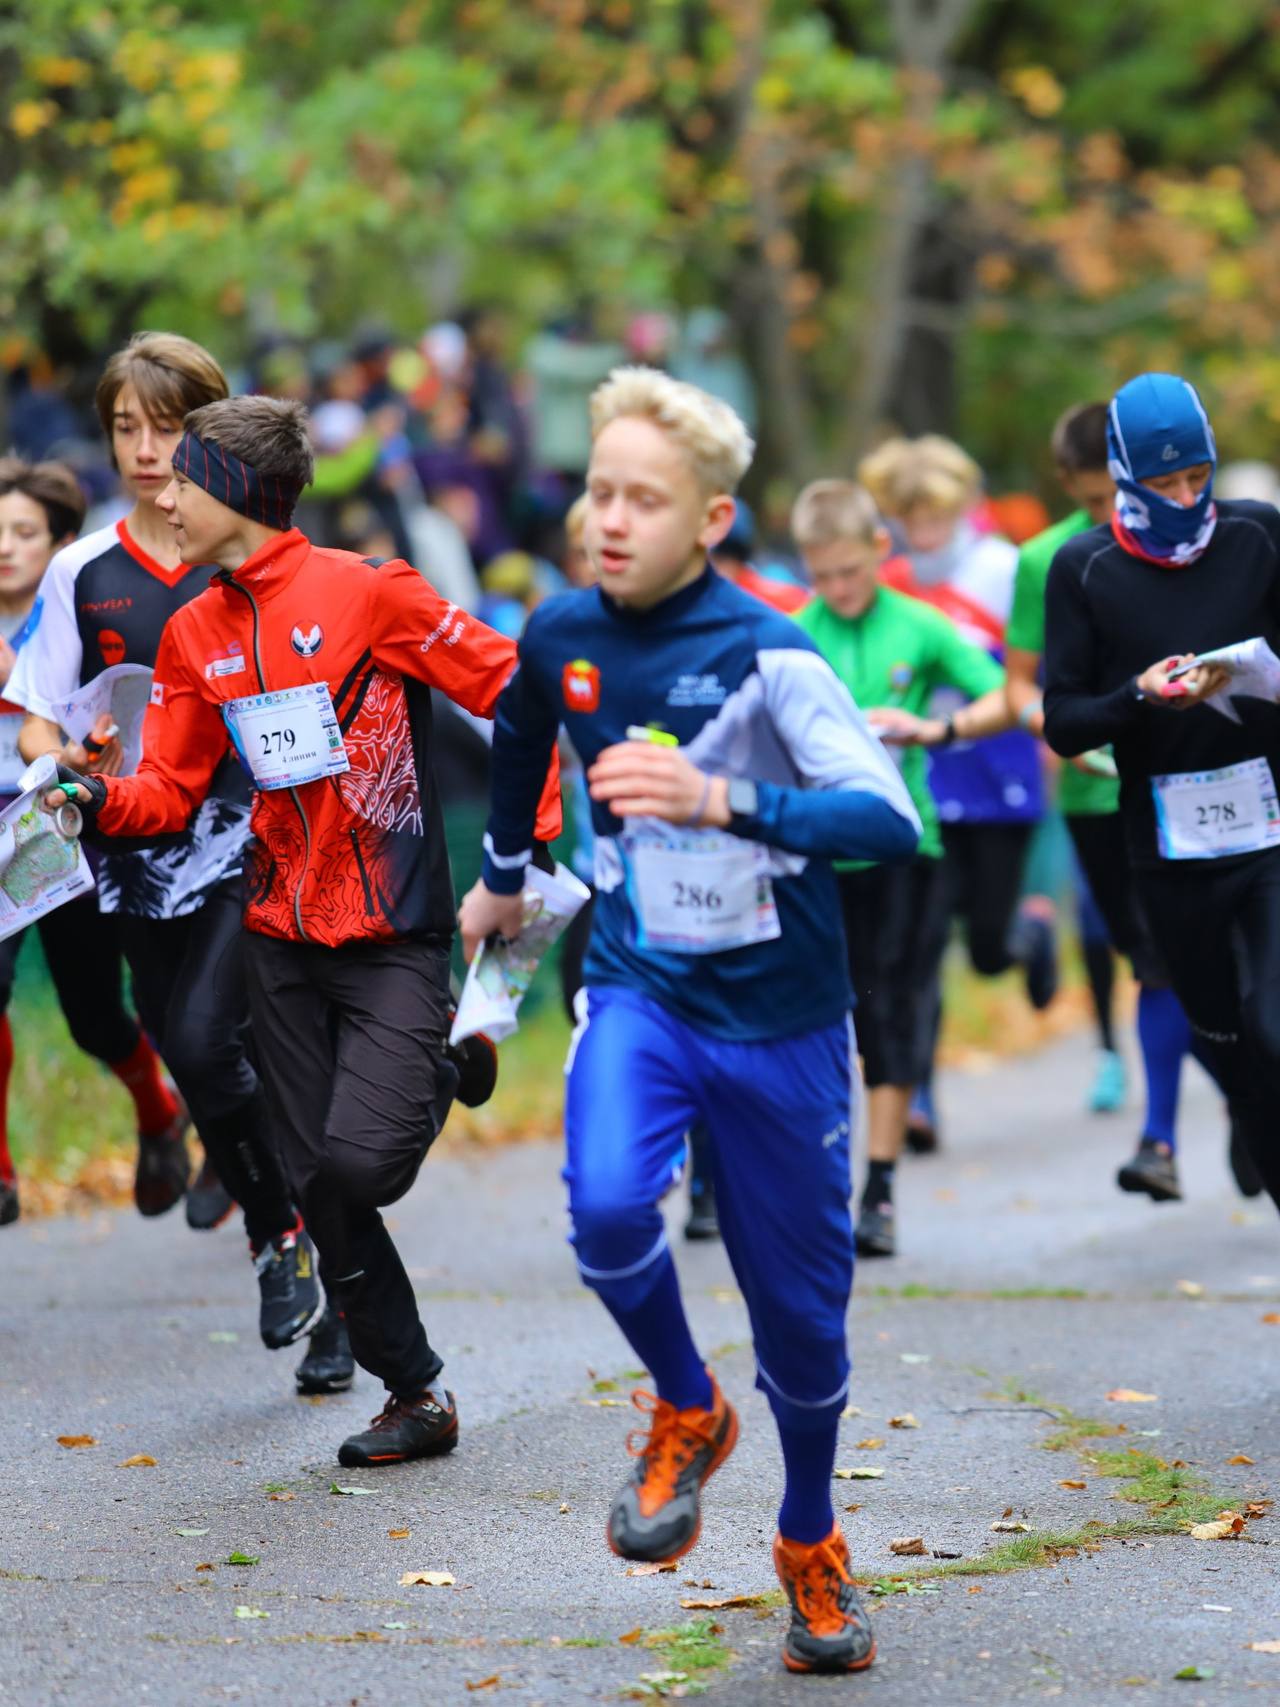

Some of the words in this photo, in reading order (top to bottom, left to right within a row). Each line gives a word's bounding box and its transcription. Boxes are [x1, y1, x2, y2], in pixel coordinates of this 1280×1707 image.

[443, 621, 466, 648] team
[260, 728, 296, 756] 279
[282, 756, 288, 764] 4
[1196, 801, 1237, 825] 278
[673, 880, 722, 910] 286
